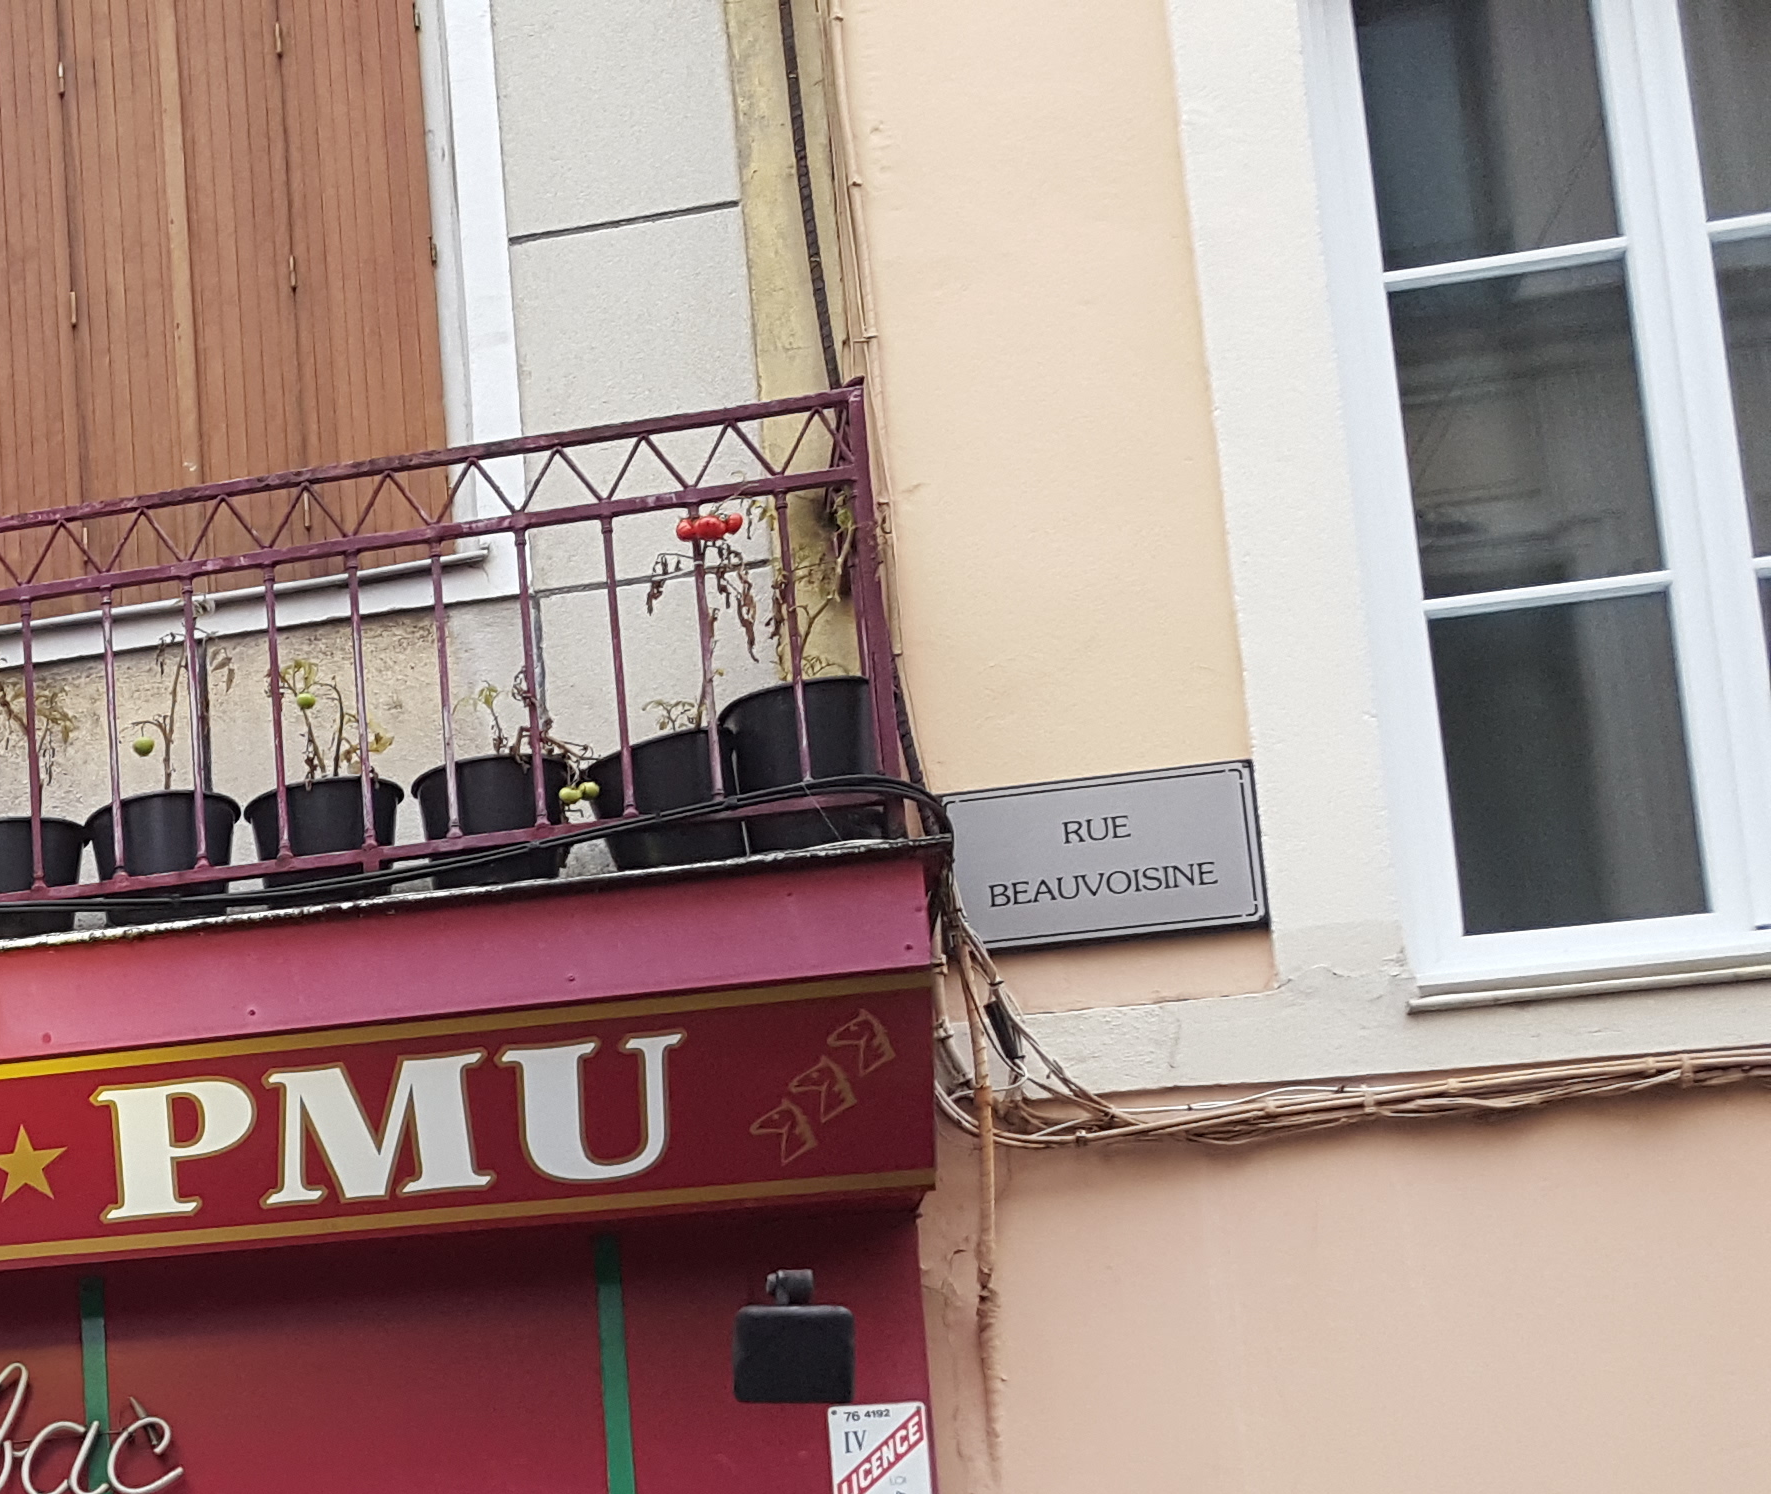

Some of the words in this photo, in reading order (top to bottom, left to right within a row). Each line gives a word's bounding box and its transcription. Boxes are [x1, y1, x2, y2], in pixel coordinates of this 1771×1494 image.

[1062, 815, 1131, 844] RUE
[989, 861, 1219, 908] BEAUVOISINE
[90, 1028, 687, 1224] PMU
[843, 1410, 861, 1422] 76
[863, 1408, 891, 1418] 4192
[844, 1429, 867, 1454] IV
